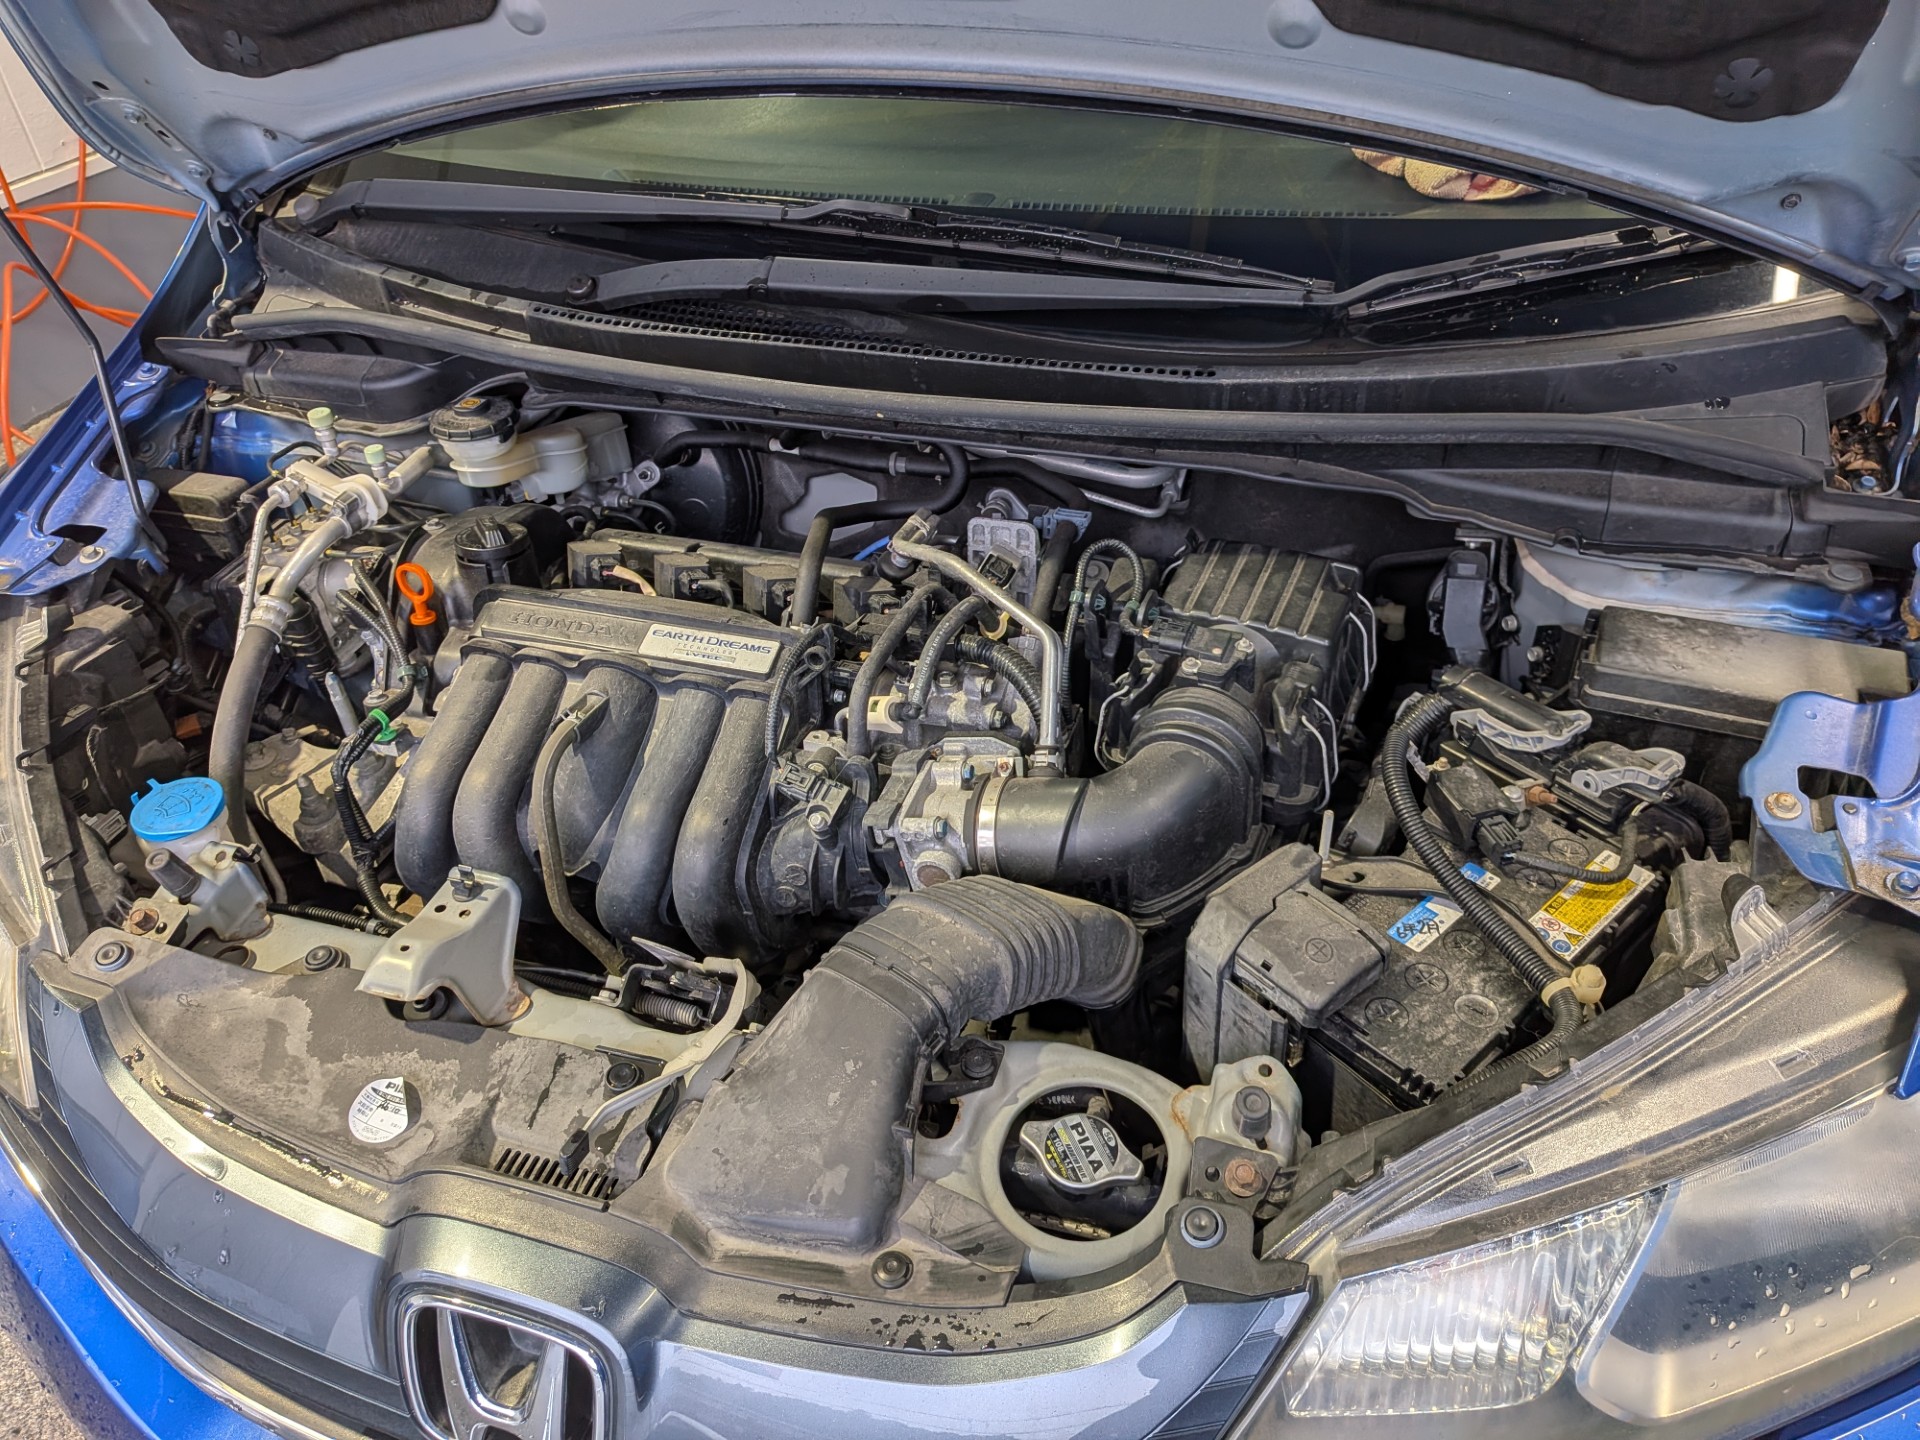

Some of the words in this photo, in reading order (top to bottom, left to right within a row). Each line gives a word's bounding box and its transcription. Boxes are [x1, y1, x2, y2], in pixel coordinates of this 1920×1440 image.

[509, 611, 613, 639] HONDA
[652, 629, 704, 644] EARTH
[706, 636, 773, 655] DREAMS
[1069, 1121, 1104, 1175] PIAA
[1104, 1131, 1113, 1143] 56
